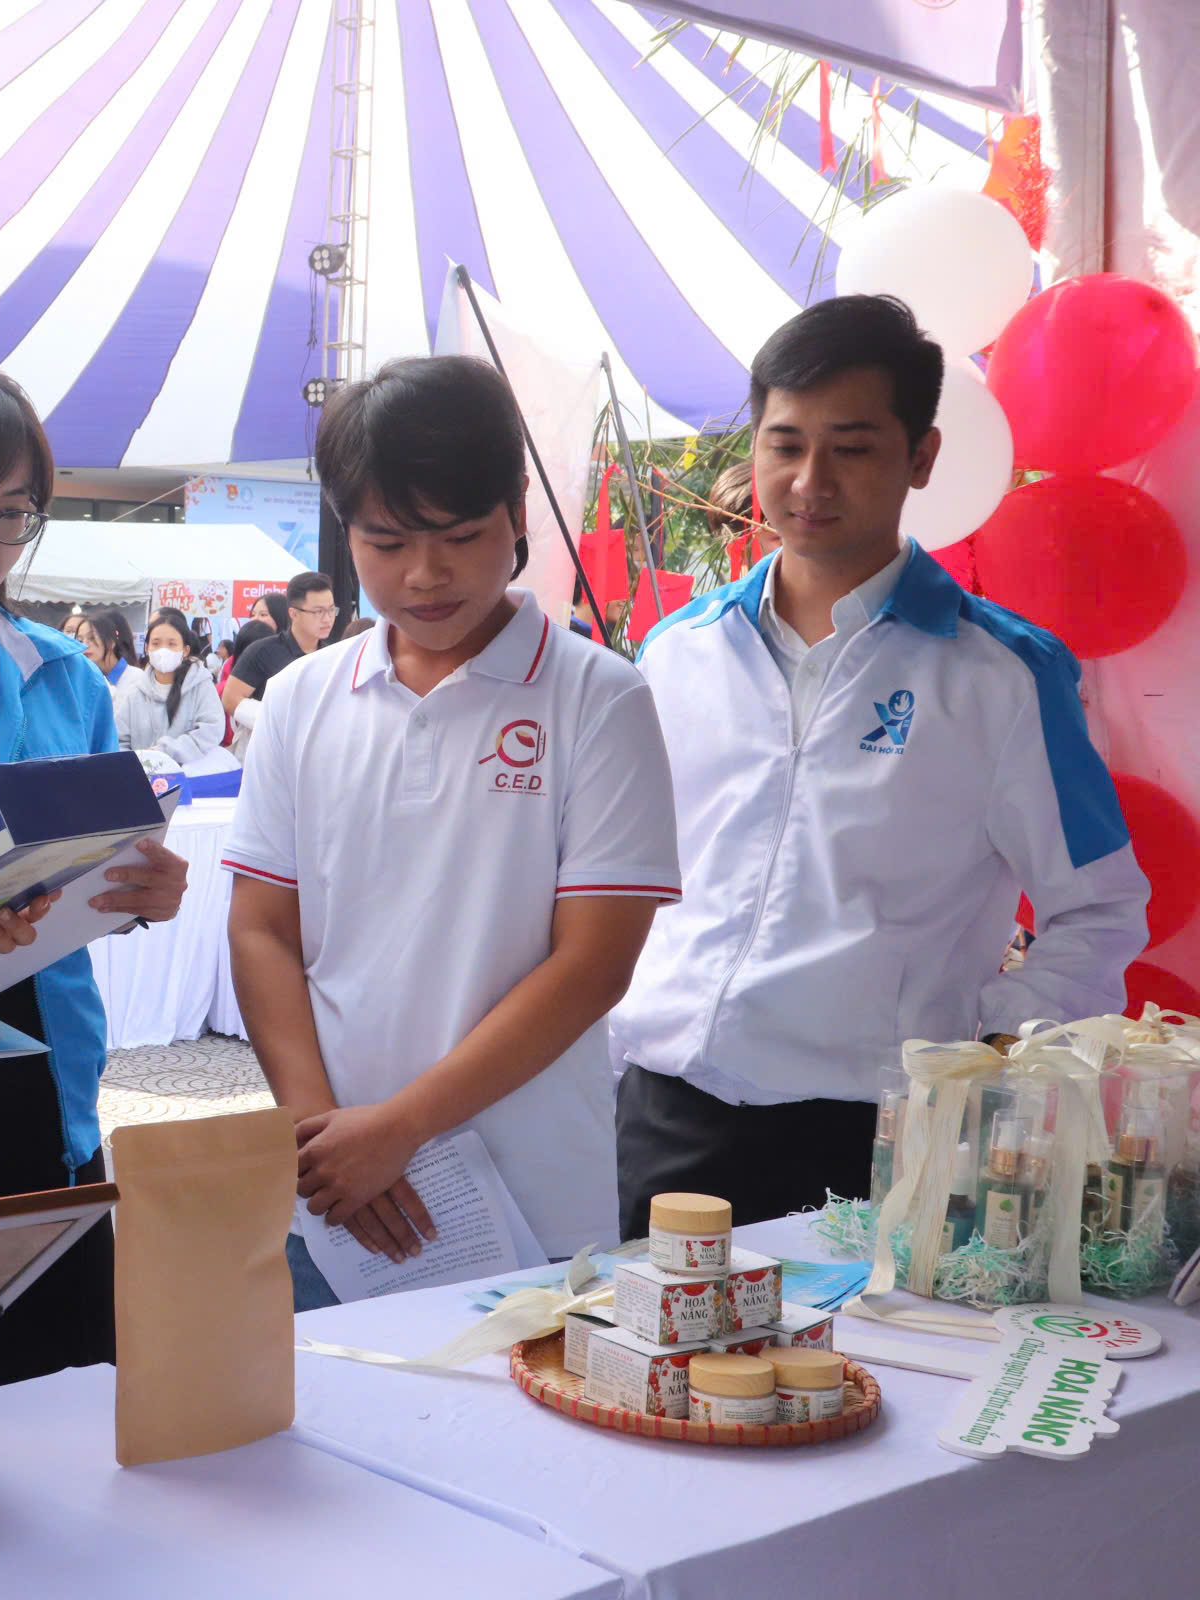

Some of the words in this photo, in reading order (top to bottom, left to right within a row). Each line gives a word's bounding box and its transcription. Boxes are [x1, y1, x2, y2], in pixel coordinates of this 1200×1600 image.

[746, 1283, 766, 1294] HOA
[685, 1297, 706, 1308] HOA
[672, 1370, 689, 1382] HO
[1047, 1358, 1102, 1394] HOA
